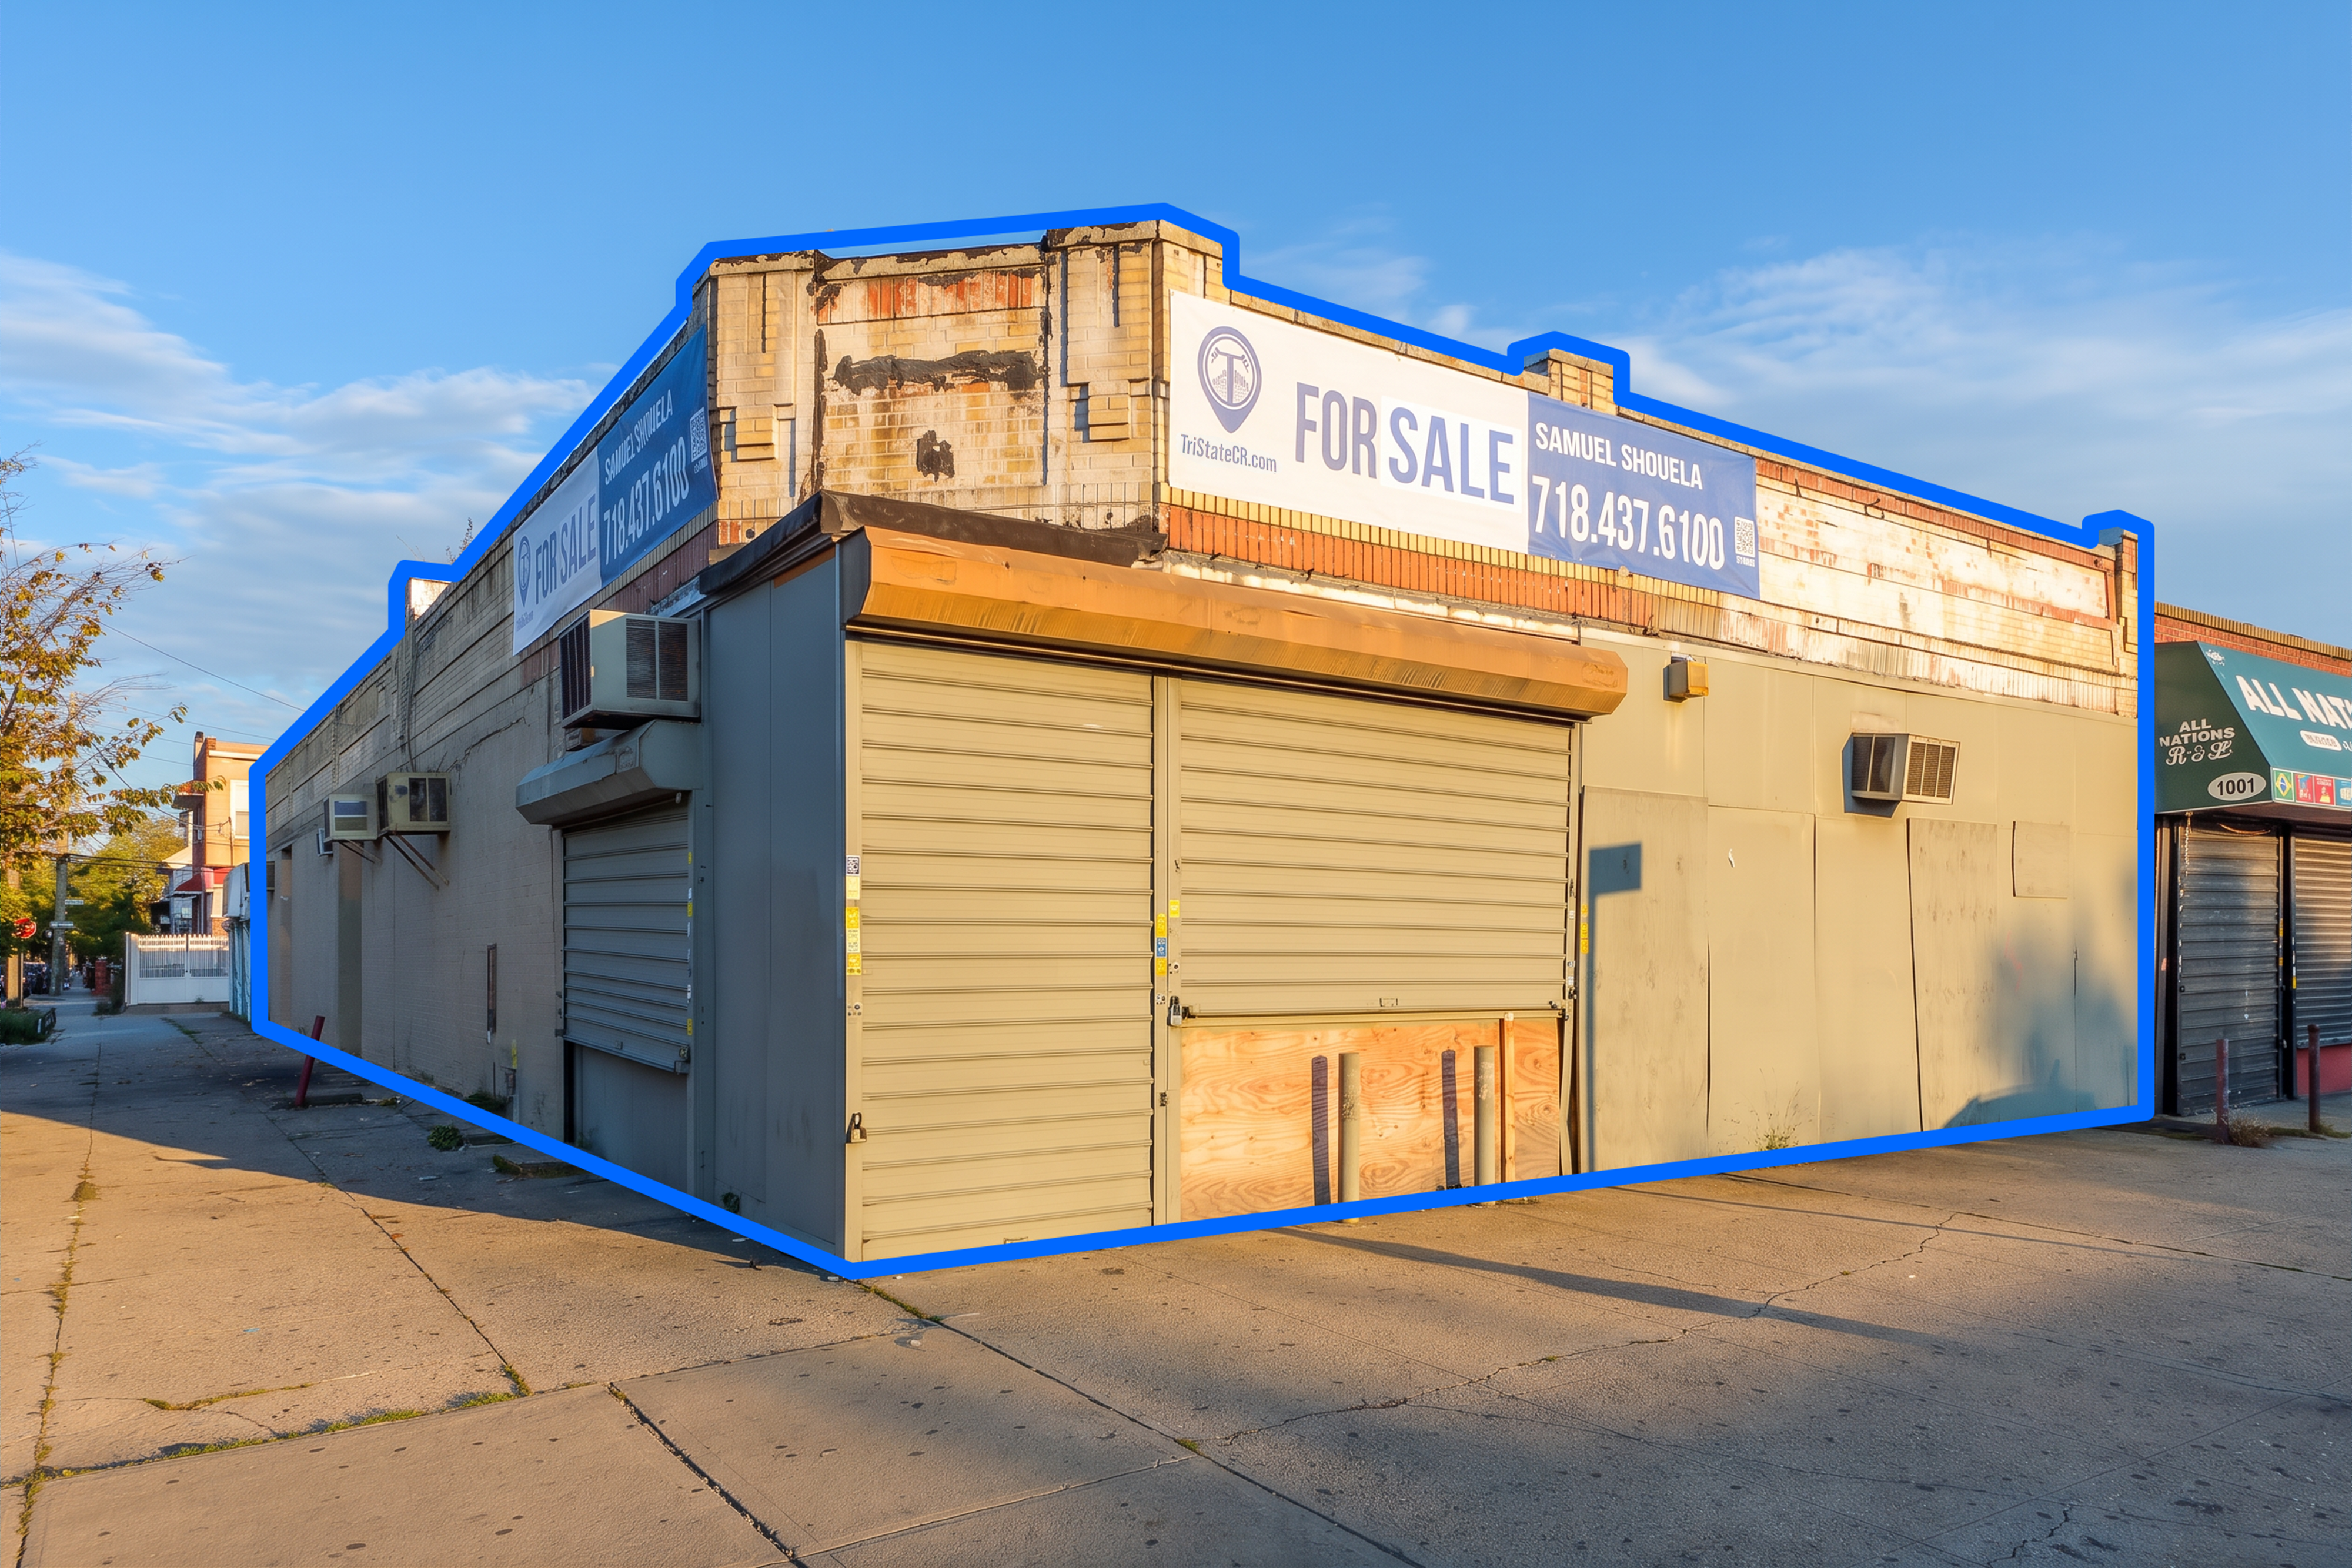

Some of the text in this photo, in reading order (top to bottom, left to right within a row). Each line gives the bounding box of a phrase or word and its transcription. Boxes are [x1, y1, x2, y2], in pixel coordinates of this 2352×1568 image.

[604, 433, 636, 486] SAMUEL
[1181, 434, 1277, 472] TriStateCR.com
[1295, 382, 1514, 505] FOR SALE
[1535, 422, 1703, 490] SAMUEL SHOUELA
[603, 436, 690, 566] 718.437.6100
[1532, 474, 1725, 570] 718.437.6100
[536, 493, 596, 605] FOR SALE
[2236, 675, 2303, 721] ALL
[2159, 727, 2236, 747] NATIONS
[2179, 718, 2212, 733] ALL
[2217, 777, 2254, 796] 1001
